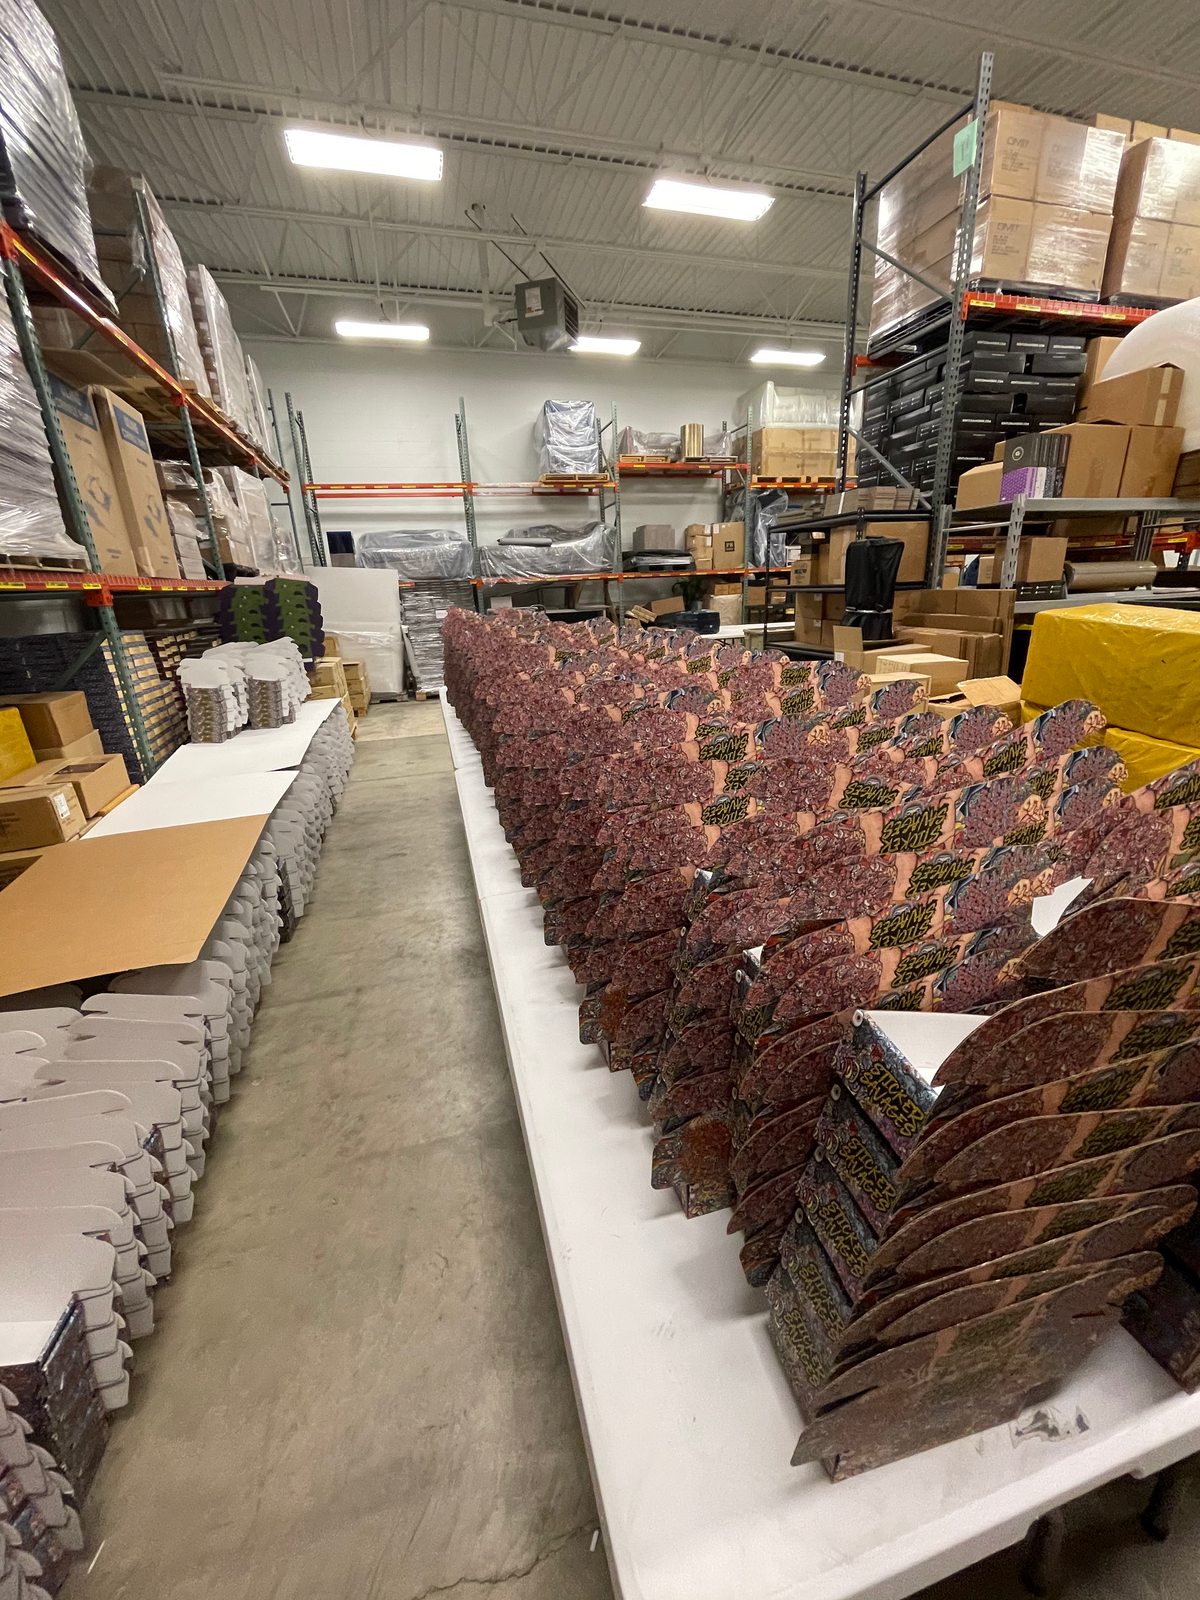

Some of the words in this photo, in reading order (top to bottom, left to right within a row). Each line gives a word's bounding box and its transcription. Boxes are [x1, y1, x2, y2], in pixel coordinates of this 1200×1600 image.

[701, 736, 748, 759] SAVAGES
[984, 739, 1027, 773] SAVAGES
[702, 798, 749, 819] SAVAGES
[844, 783, 897, 804] SAVAGES
[1155, 774, 1200, 808] AVAGES
[703, 810, 745, 825] STICKER
[881, 805, 947, 840] SAVAGES
[881, 829, 938, 852] STICKER
[910, 862, 973, 880] SAVAGES
[869, 920, 928, 949] STICKER
[870, 902, 935, 938] SAVAGES
[897, 948, 958, 972] SAVAGES
[860, 1071, 917, 1137] SAVAGES
[870, 1063, 925, 1123] STICKER
[840, 1145, 890, 1211] SAVAGES
[849, 1138, 897, 1200] STICKER
[819, 1208, 864, 1278] SAVAGES
[829, 1201, 870, 1269] STICKER
[799, 1267, 840, 1341] SAVAGES
[806, 1263, 845, 1333] STICKER
[784, 1315, 821, 1387] SAVAGES
[791, 1310, 826, 1379] STICKER
